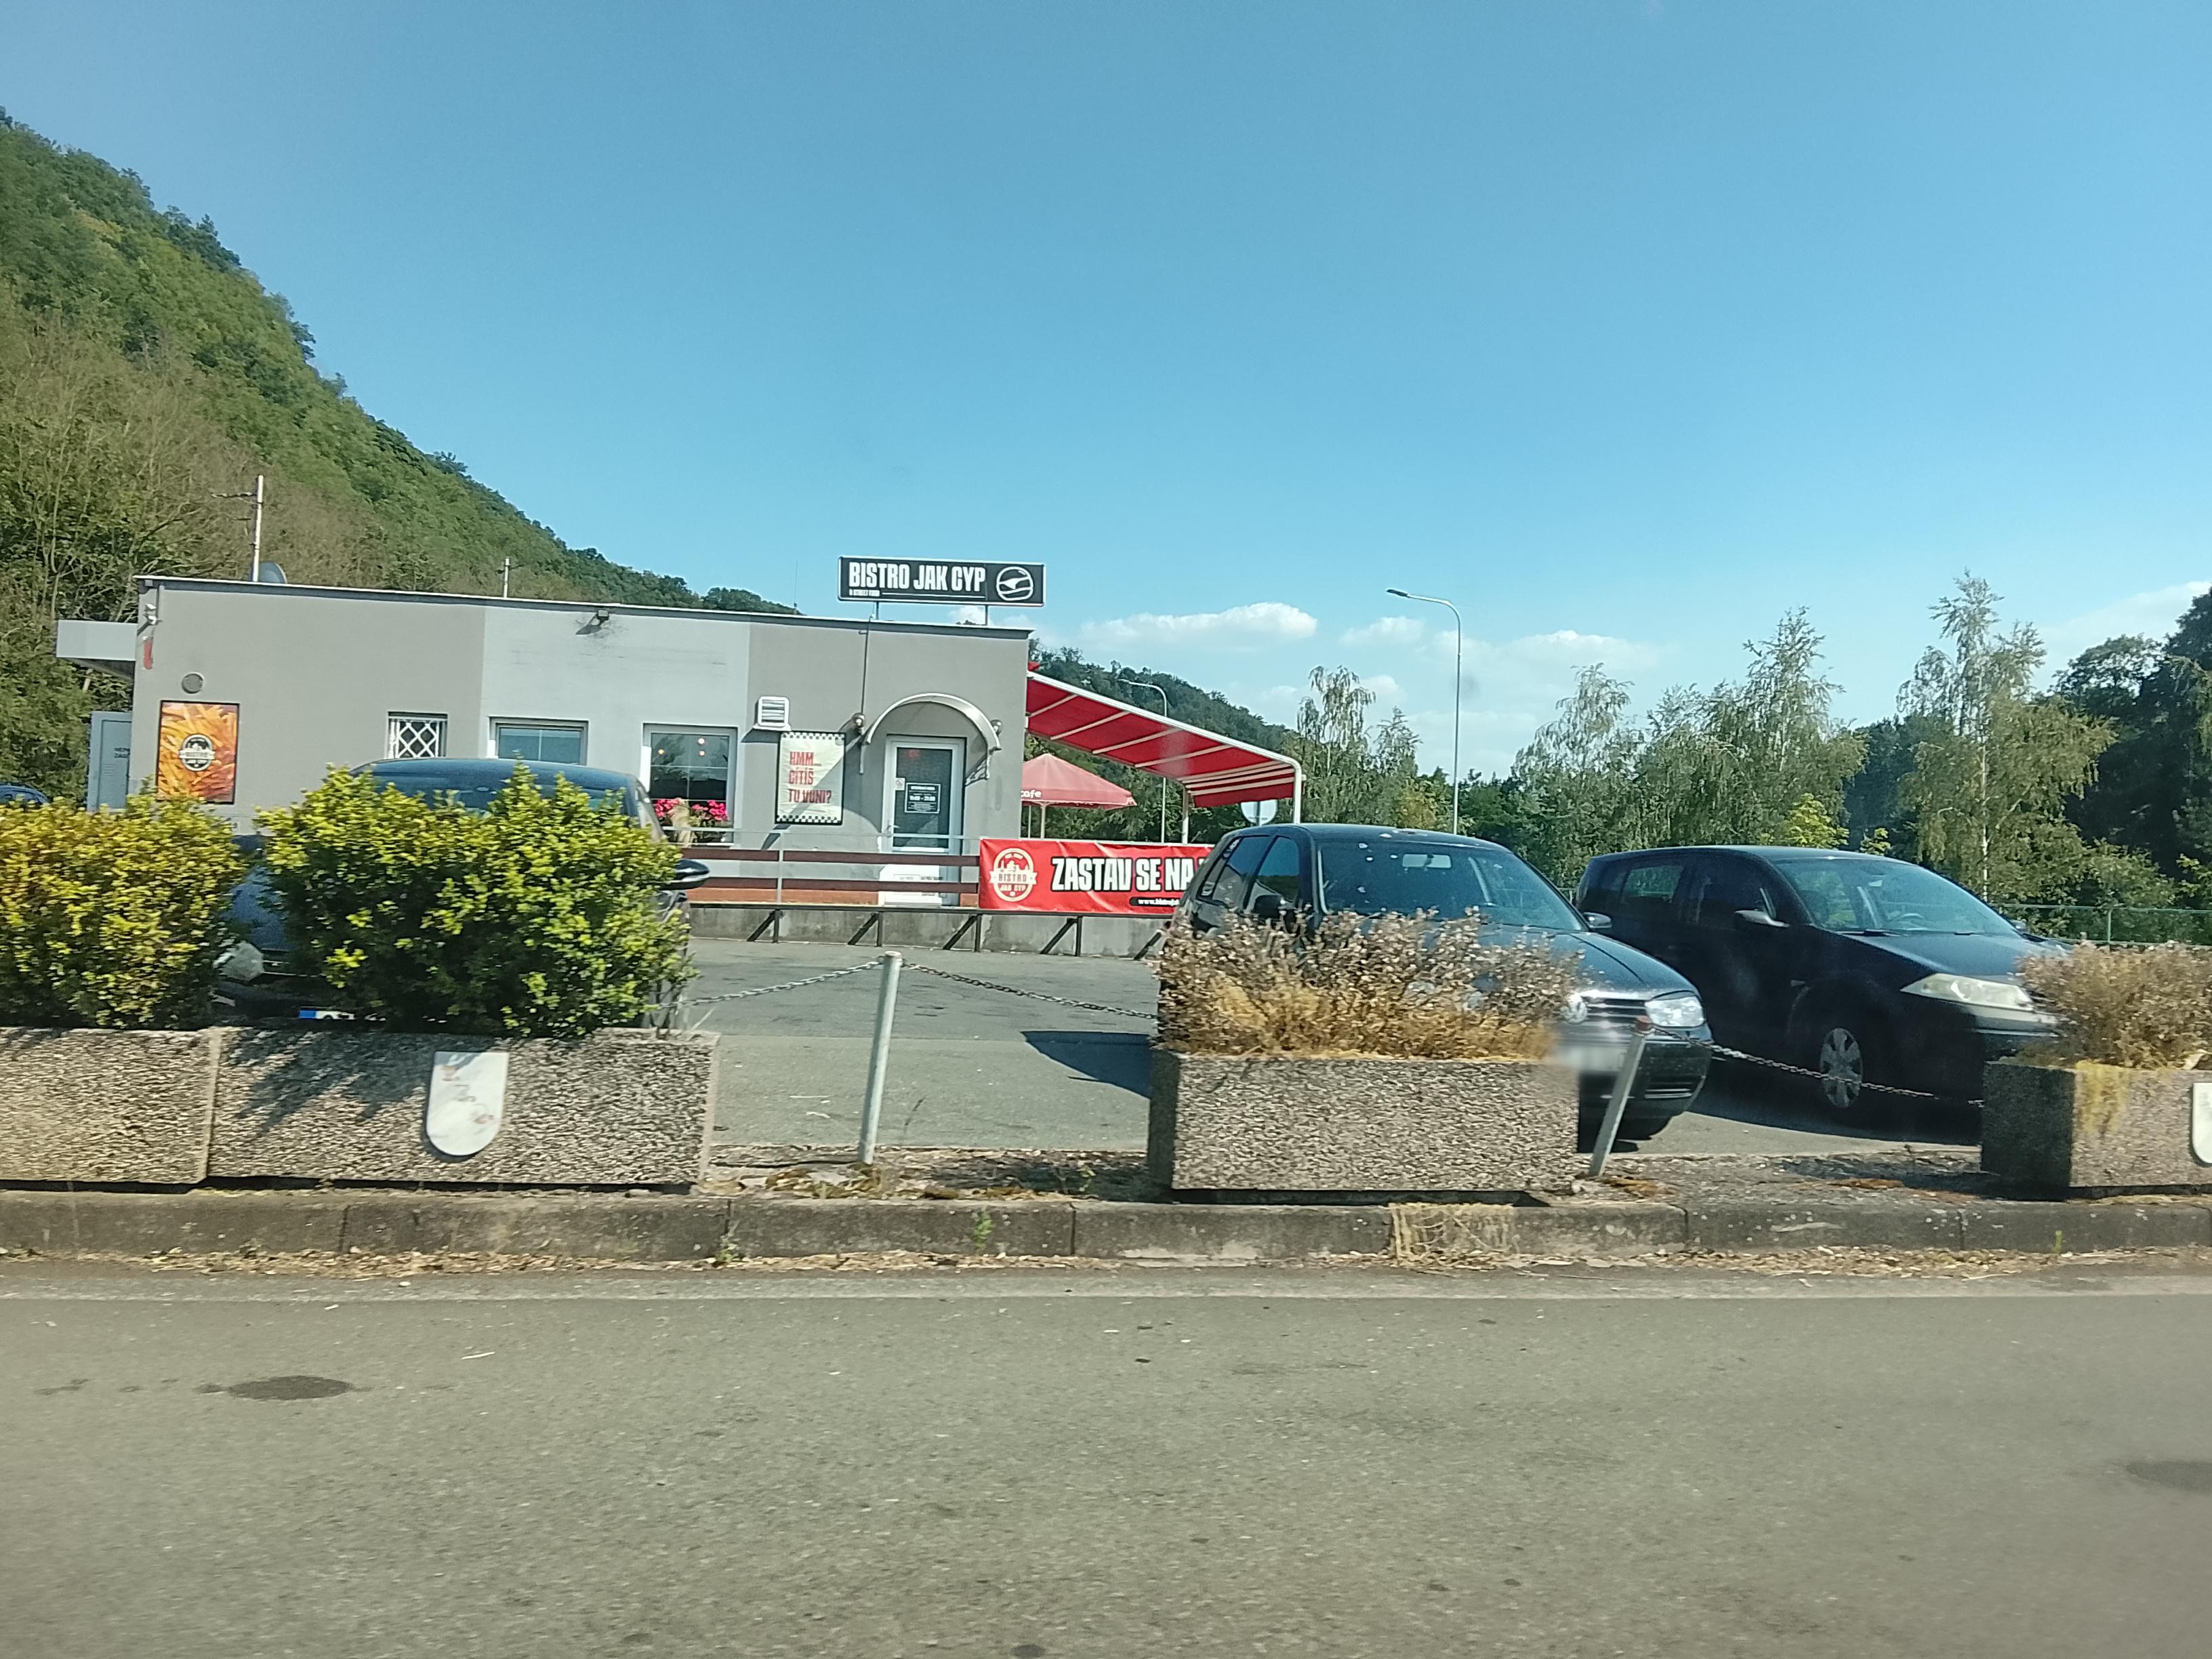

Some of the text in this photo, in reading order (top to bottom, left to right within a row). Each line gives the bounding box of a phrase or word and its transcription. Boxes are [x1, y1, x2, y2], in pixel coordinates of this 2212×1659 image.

[848, 561, 986, 592] BISTRO JAK CYP
[998, 873, 1027, 882] BISTRO
[1052, 858, 1195, 891] ZASTAV SE NA
